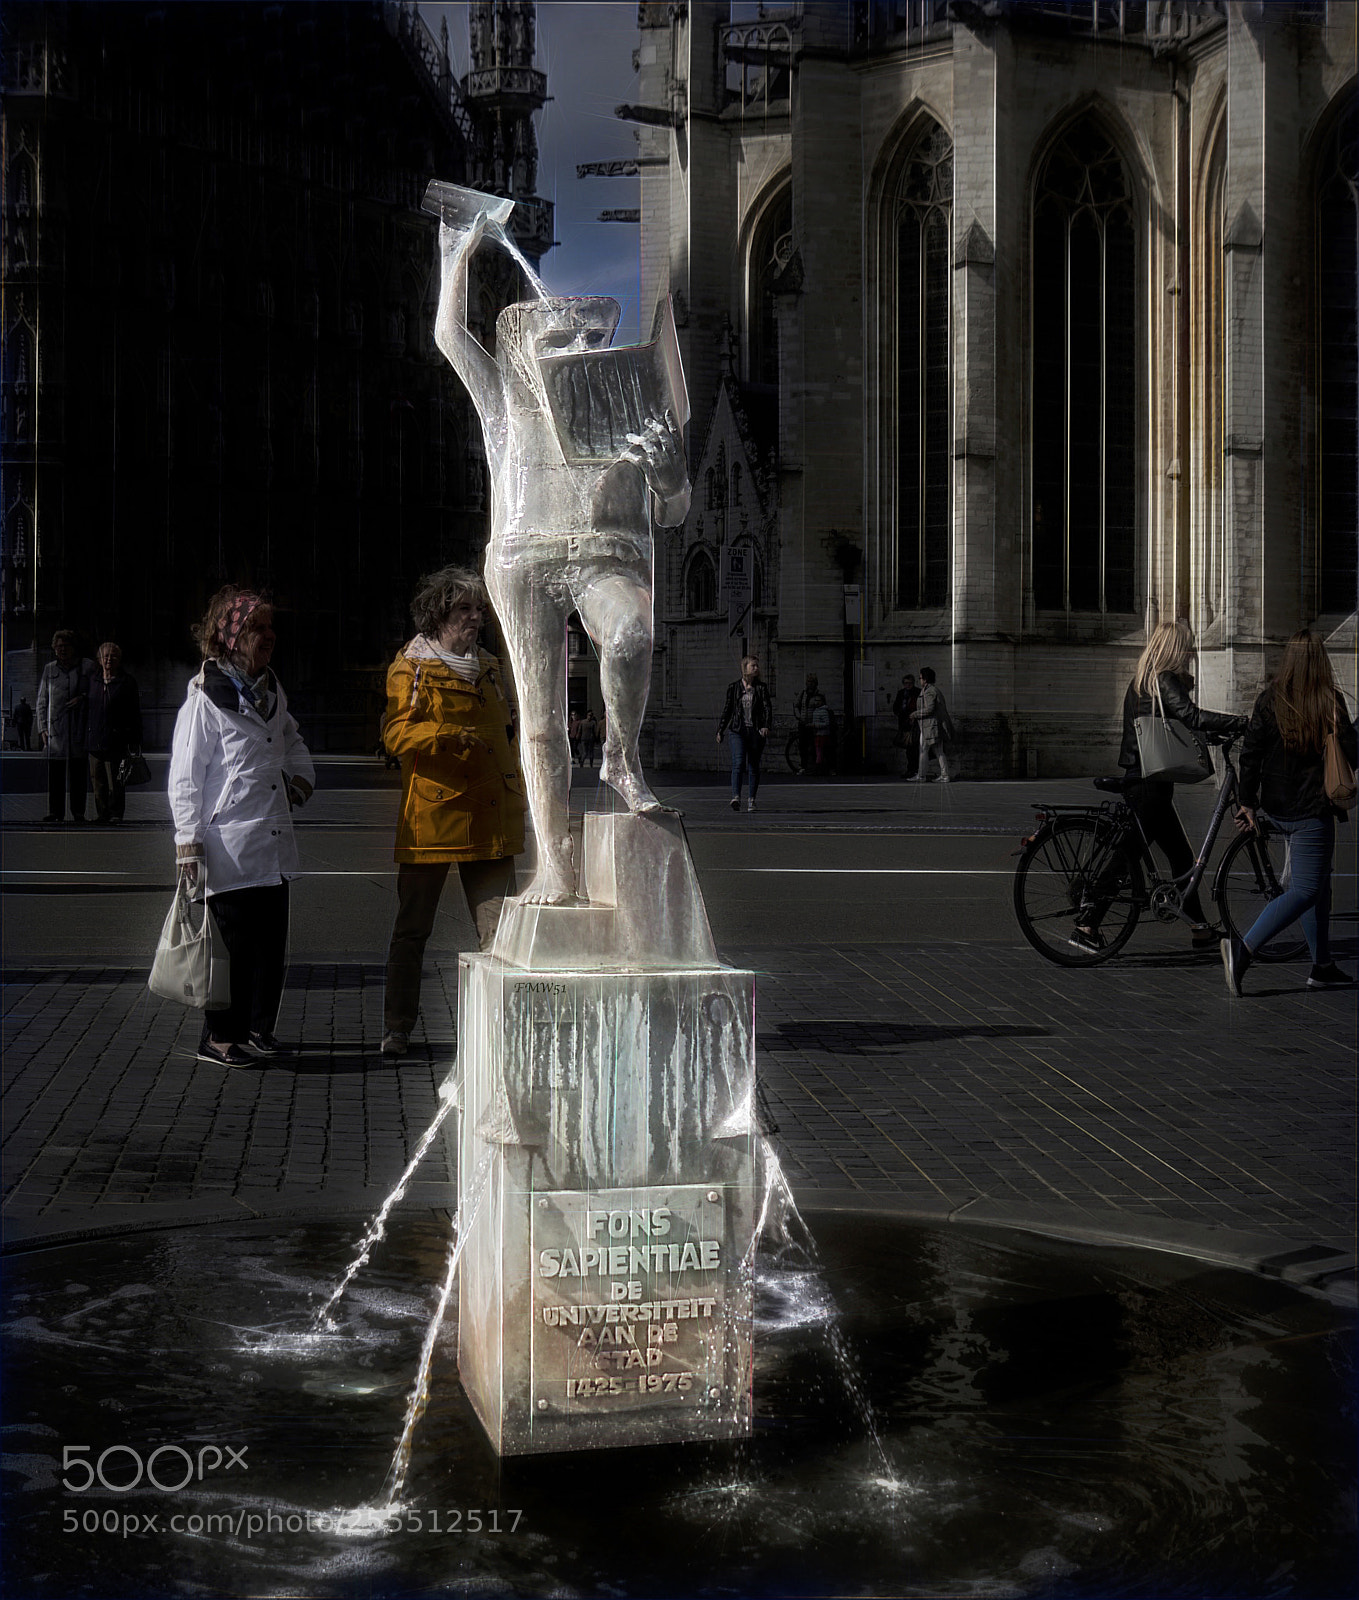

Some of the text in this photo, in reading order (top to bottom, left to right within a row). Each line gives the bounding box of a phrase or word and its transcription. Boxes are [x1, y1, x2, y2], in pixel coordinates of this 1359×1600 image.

[727, 548, 748, 556] ZONE
[587, 1207, 672, 1239] FONS
[539, 1241, 721, 1278] SAPIENTIAE
[611, 1280, 642, 1301] DE
[543, 1297, 716, 1326] UNIVERSITEIT
[577, 1322, 679, 1347] AAN DE
[594, 1347, 663, 1370] STAD
[566, 1372, 693, 1398] 1425-1975
